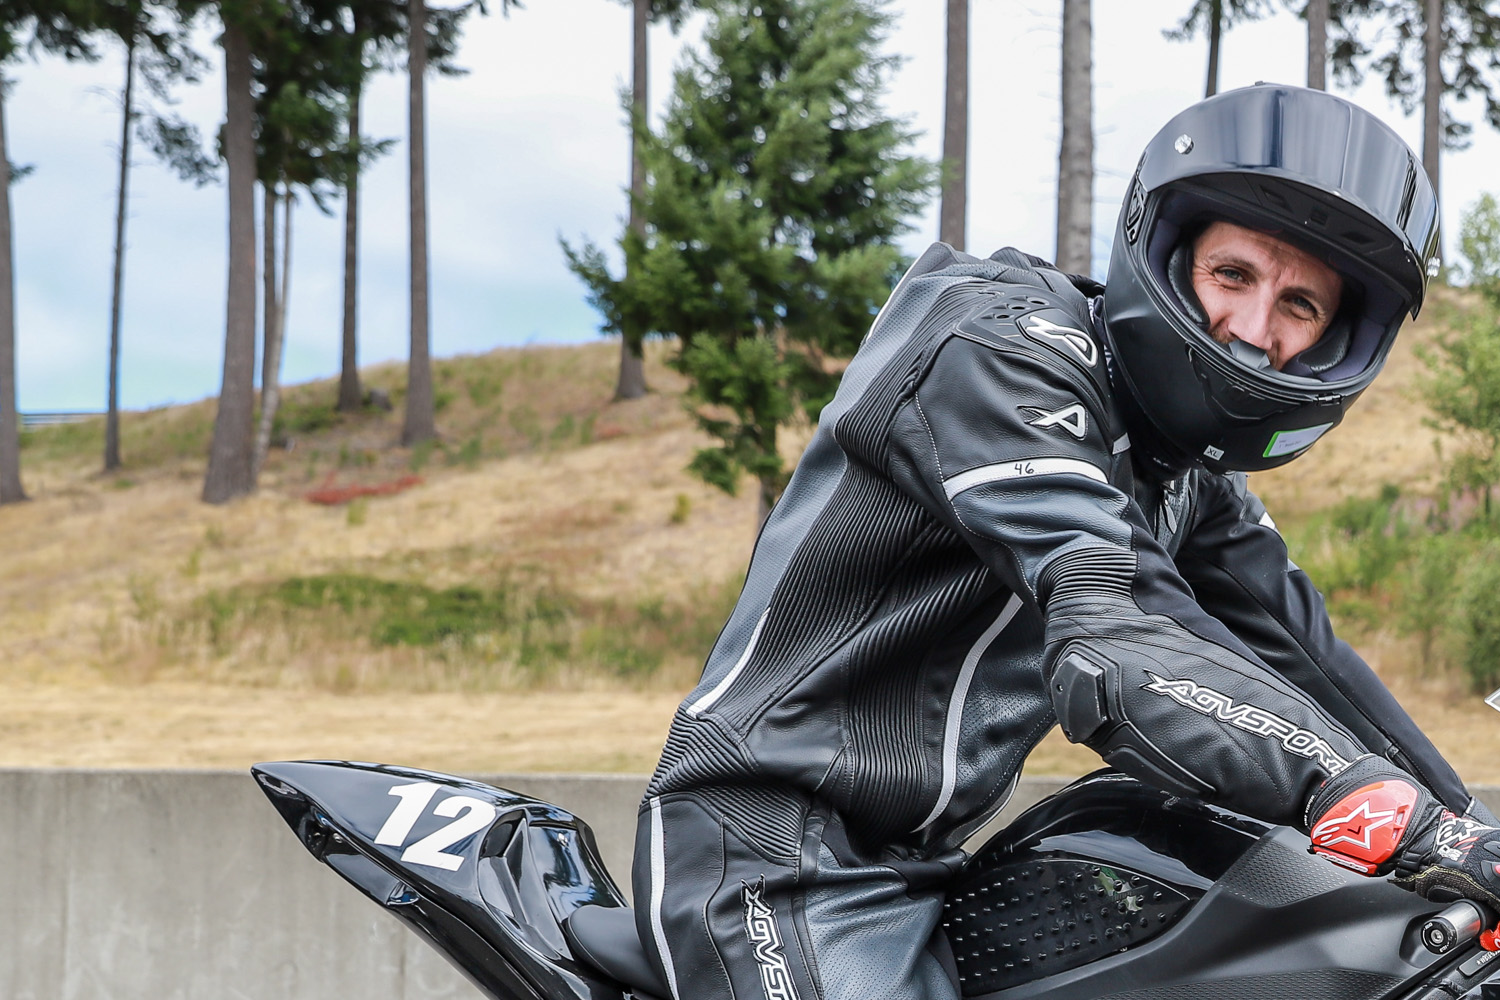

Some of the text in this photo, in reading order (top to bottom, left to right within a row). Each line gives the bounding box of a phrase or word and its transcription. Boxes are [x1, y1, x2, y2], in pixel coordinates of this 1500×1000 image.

[1206, 447, 1220, 458] XL
[1013, 461, 1036, 475] 46
[373, 782, 497, 872] 12
